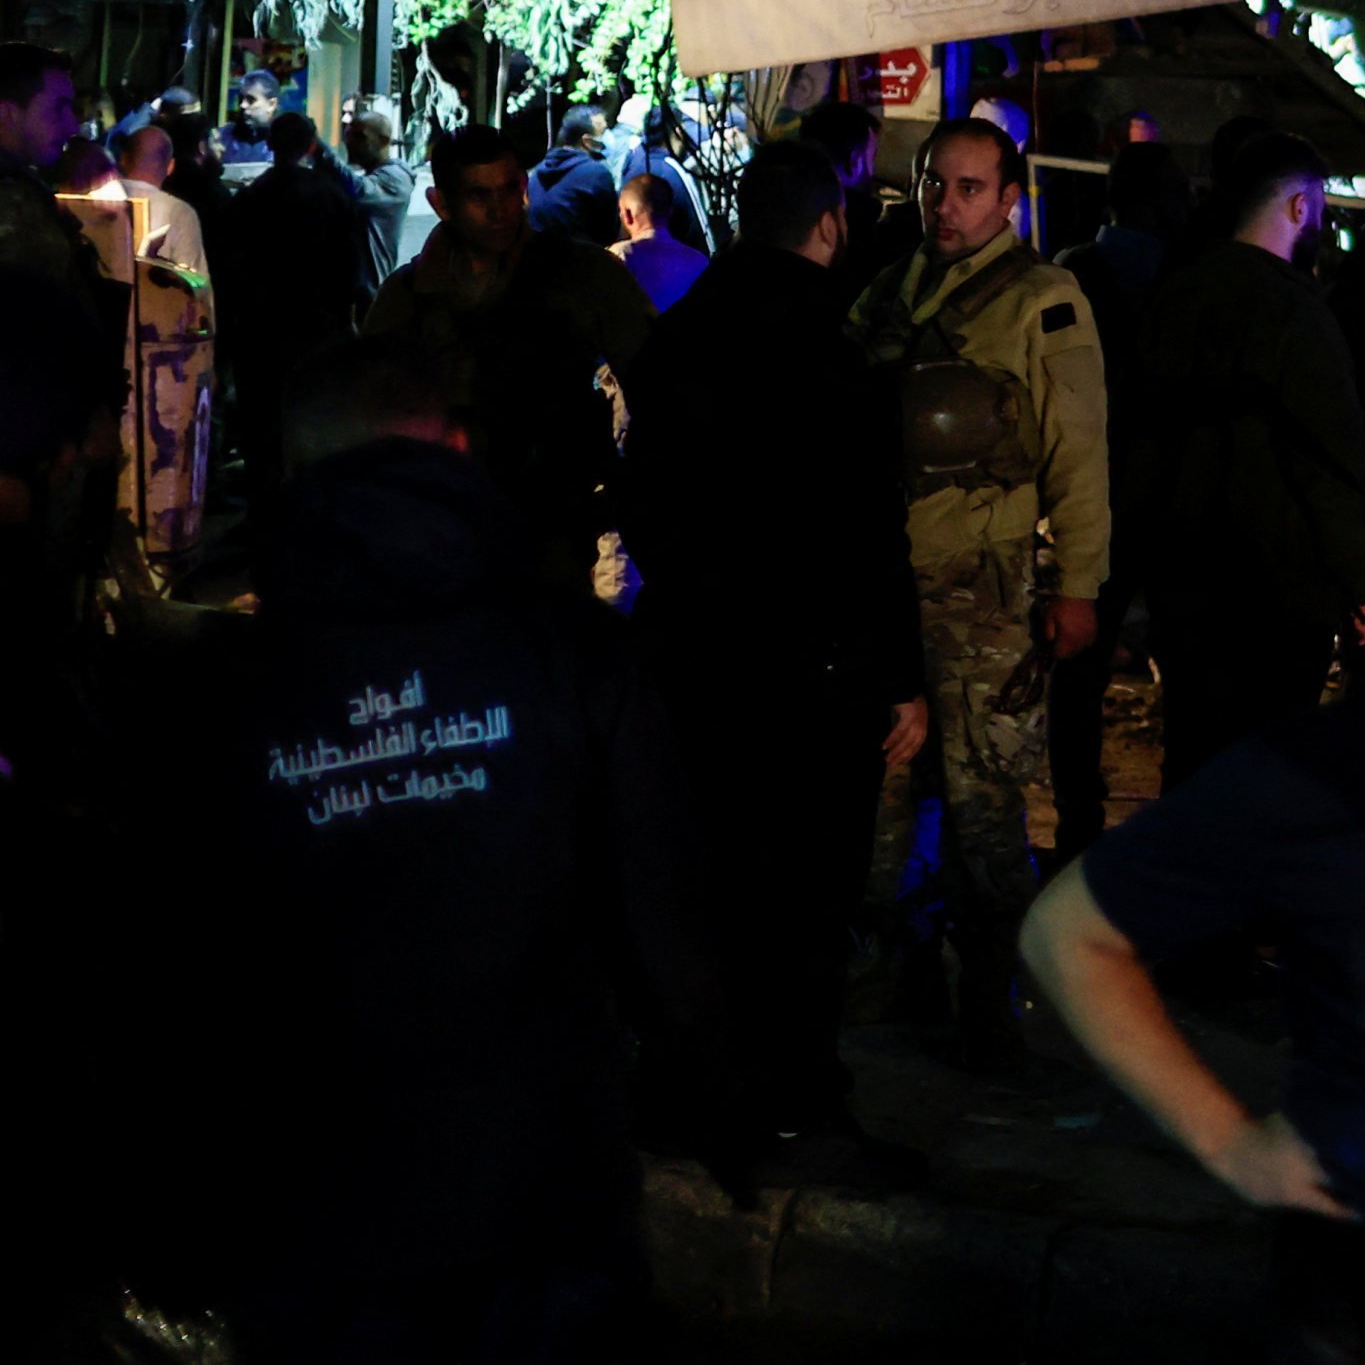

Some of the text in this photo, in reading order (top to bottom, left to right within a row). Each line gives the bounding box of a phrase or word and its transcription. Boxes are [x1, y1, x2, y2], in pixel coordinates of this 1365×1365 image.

[268, 720, 418, 786] الفلسطينية
[307, 762, 489, 826] مخيمات لبنان
